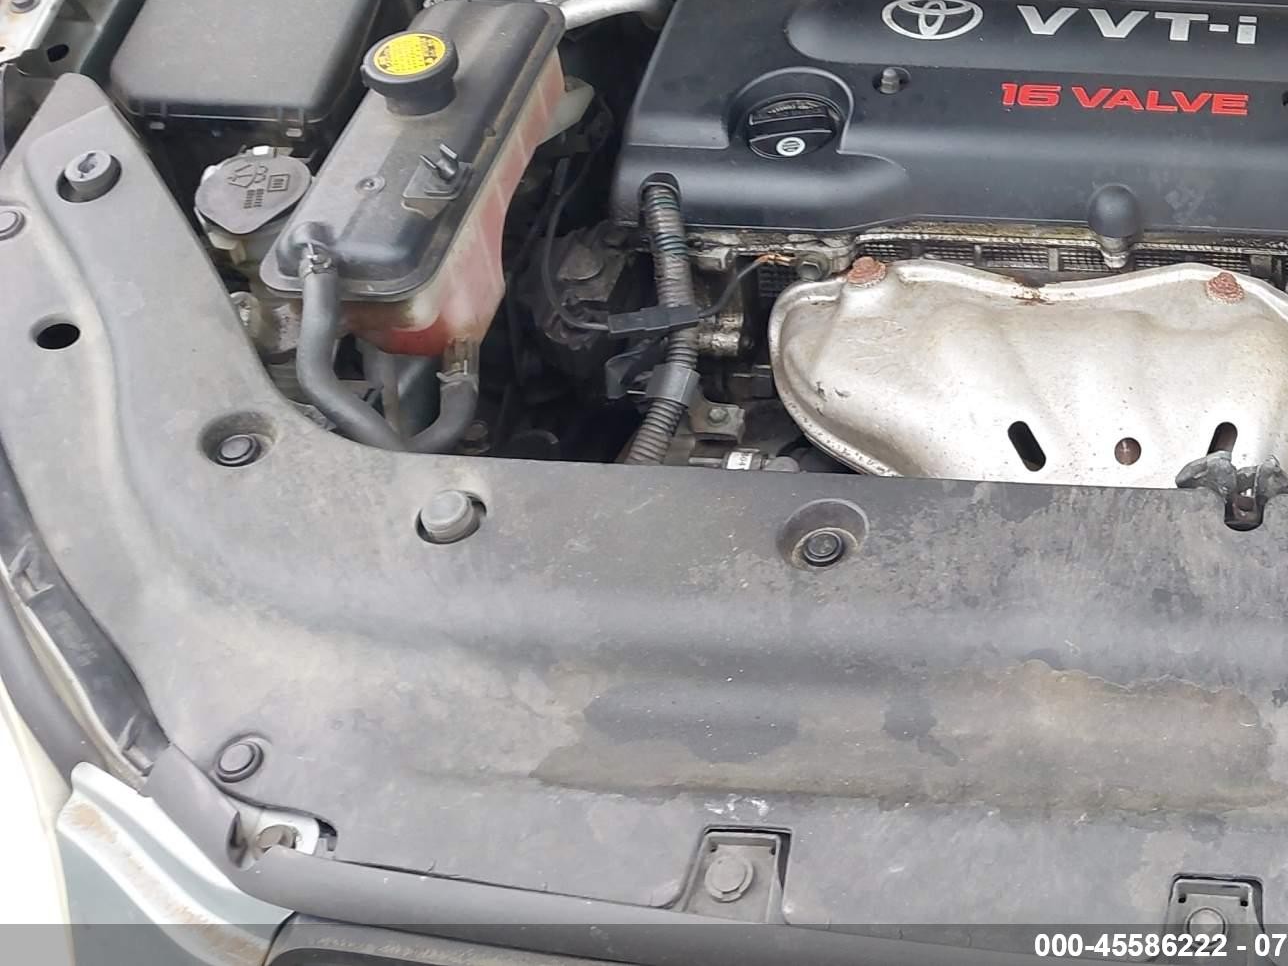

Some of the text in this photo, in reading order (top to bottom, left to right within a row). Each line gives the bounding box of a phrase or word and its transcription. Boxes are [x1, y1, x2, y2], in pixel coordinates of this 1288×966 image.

[1017, 5, 1257, 44] VVT-i
[1002, 84, 1248, 115] 16 VALVE
